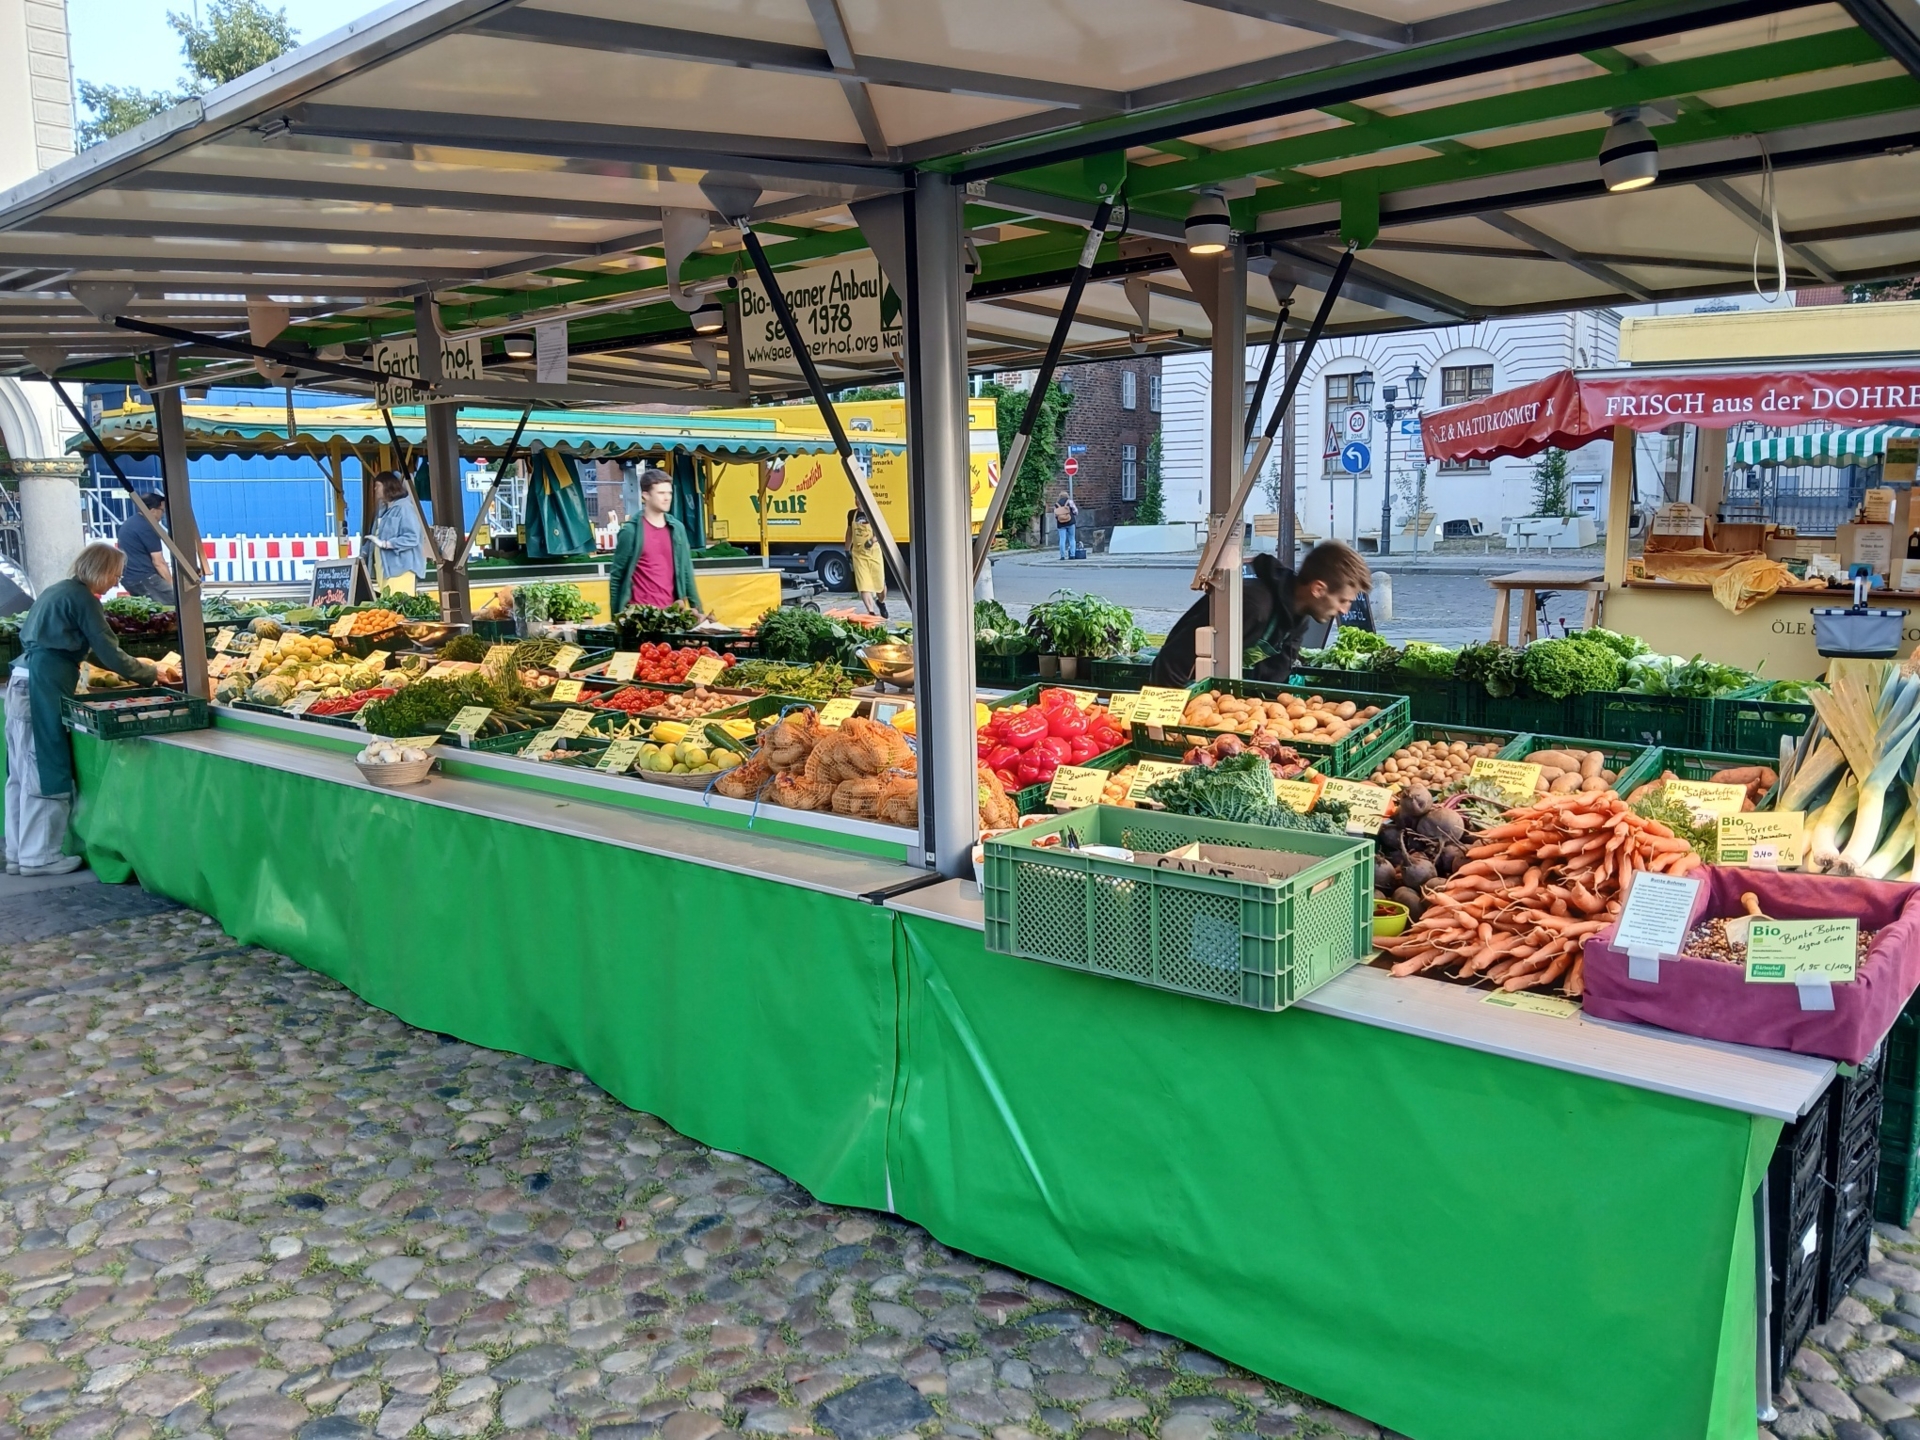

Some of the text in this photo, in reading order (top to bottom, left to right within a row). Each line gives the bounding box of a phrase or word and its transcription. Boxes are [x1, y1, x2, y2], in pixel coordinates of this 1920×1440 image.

[741, 269, 878, 317] Bio-ganer Anbau
[765, 303, 853, 342] set 1978
[377, 340, 474, 376] Gärthof
[1604, 392, 1705, 417] FRISCH
[1712, 396, 1754, 414] aus
[1760, 389, 1804, 412] der
[1352, 417, 1362, 428] 20
[1447, 422, 1454, 441] &
[1457, 397, 1556, 439] NATURKOSMETK
[749, 494, 807, 514] Wulf
[1771, 618, 1807, 636] ÖLE
[1142, 689, 1156, 697] Bio
[1058, 766, 1072, 776] Bio
[1140, 764, 1154, 773] Bio
[1476, 760, 1494, 769] Bio
[1325, 781, 1344, 792] Bio
[1668, 782, 1689, 792] Bio
[1349, 814, 1366, 823] ,95
[1721, 816, 1782, 836] Bio Porree
[1752, 924, 1852, 945] Bio Bunte Bohnen
